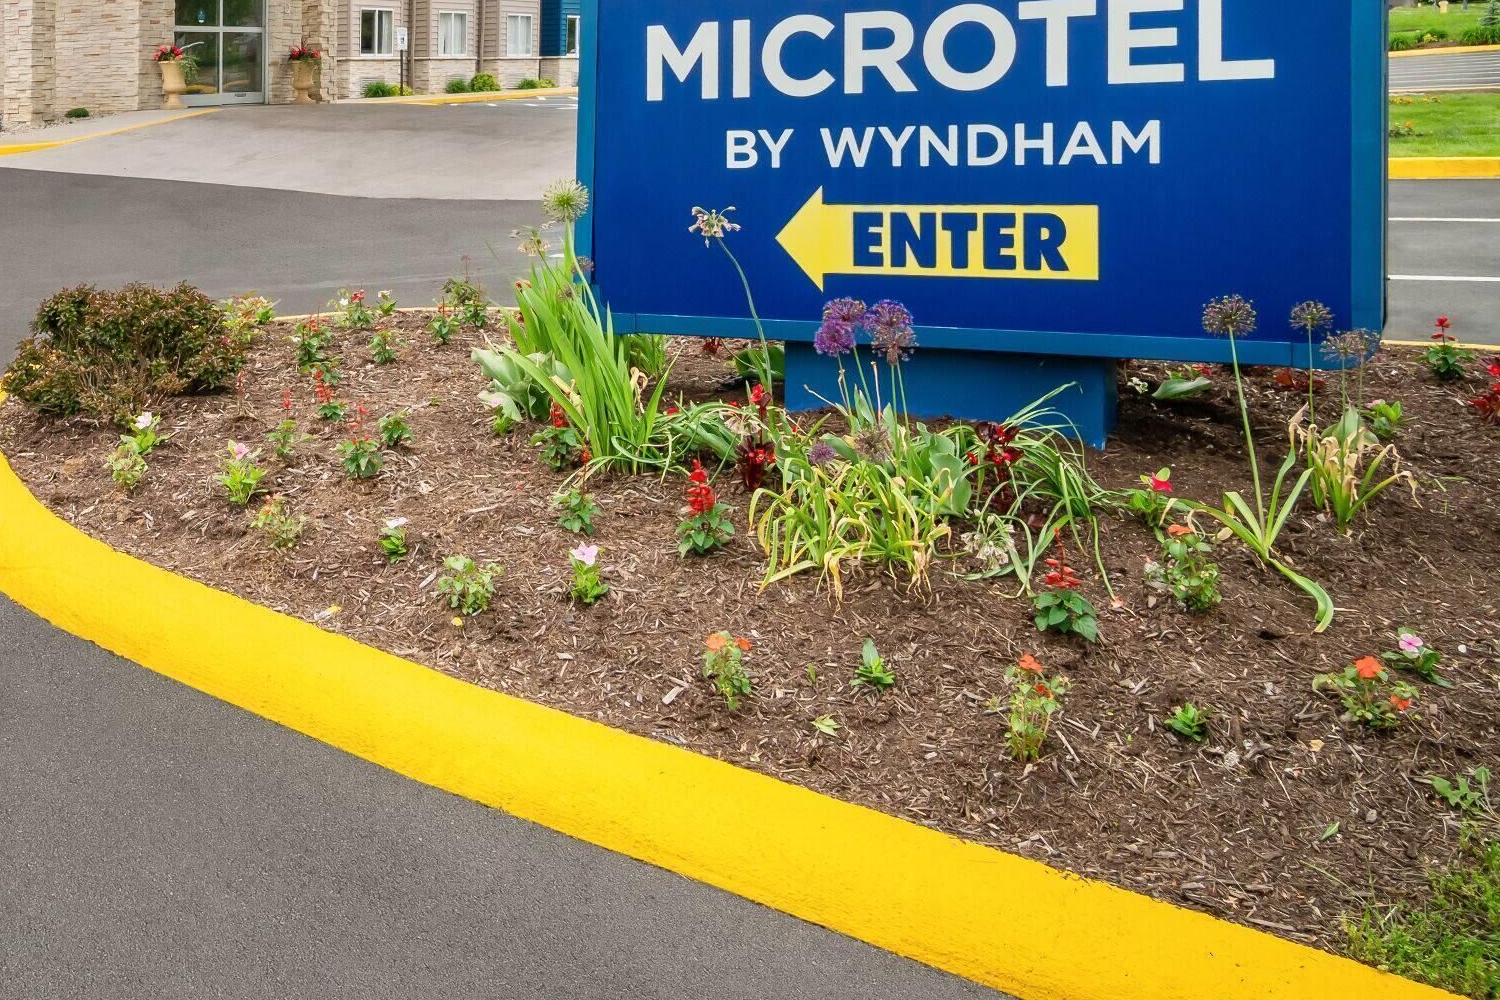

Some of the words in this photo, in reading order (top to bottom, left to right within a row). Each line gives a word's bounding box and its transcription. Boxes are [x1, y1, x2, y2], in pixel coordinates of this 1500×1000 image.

[726, 129, 794, 169] BY
[820, 120, 1161, 168] WYNDHAM
[852, 212, 1070, 271] ENTER
